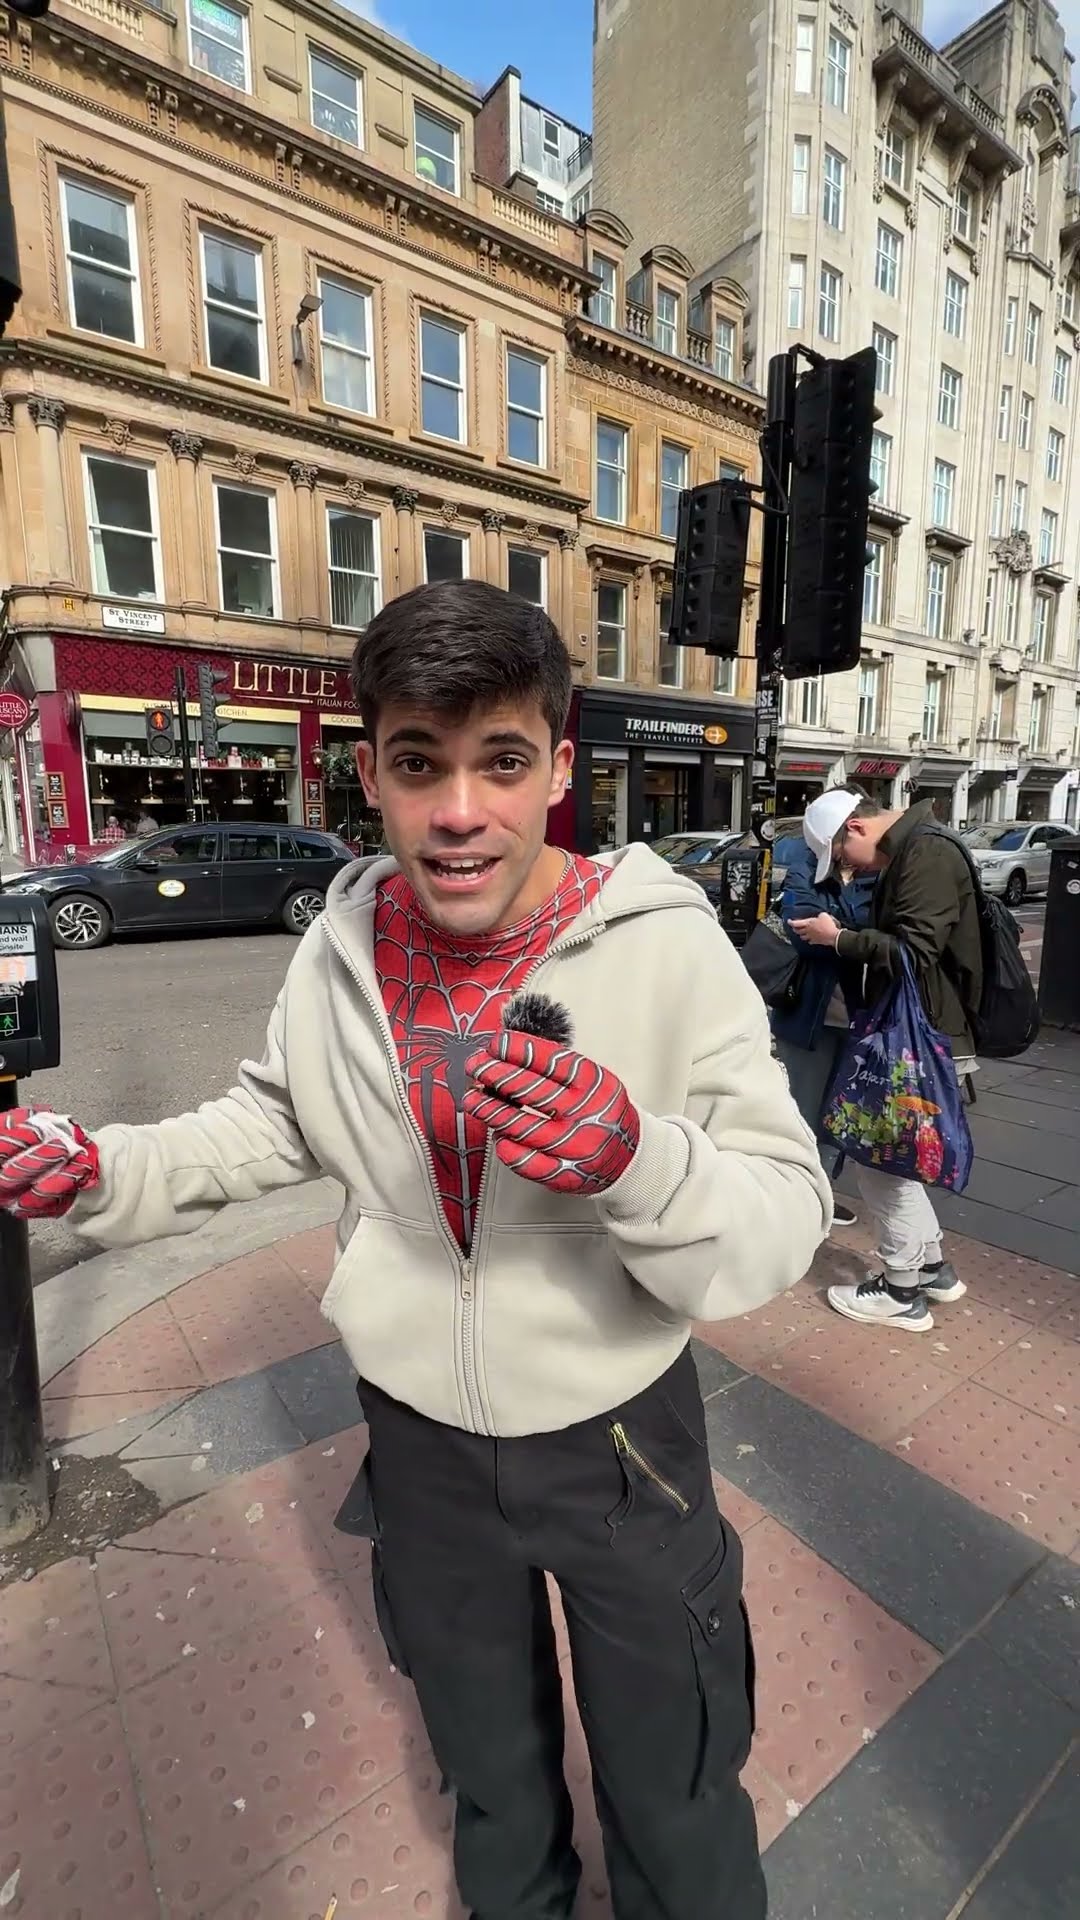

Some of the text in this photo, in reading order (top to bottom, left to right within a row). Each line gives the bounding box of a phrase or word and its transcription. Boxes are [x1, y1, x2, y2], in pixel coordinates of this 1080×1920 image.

[123, 610, 158, 621] VINCENT
[118, 616, 150, 627] STREET
[233, 661, 337, 697] LITTLE
[317, 699, 341, 708] ITALIAN
[625, 718, 705, 736] TRAILFINDERS
[643, 733, 670, 742] TRAVEL
[673, 736, 703, 744] EXPERTS
[11, 935, 28, 943] wait
